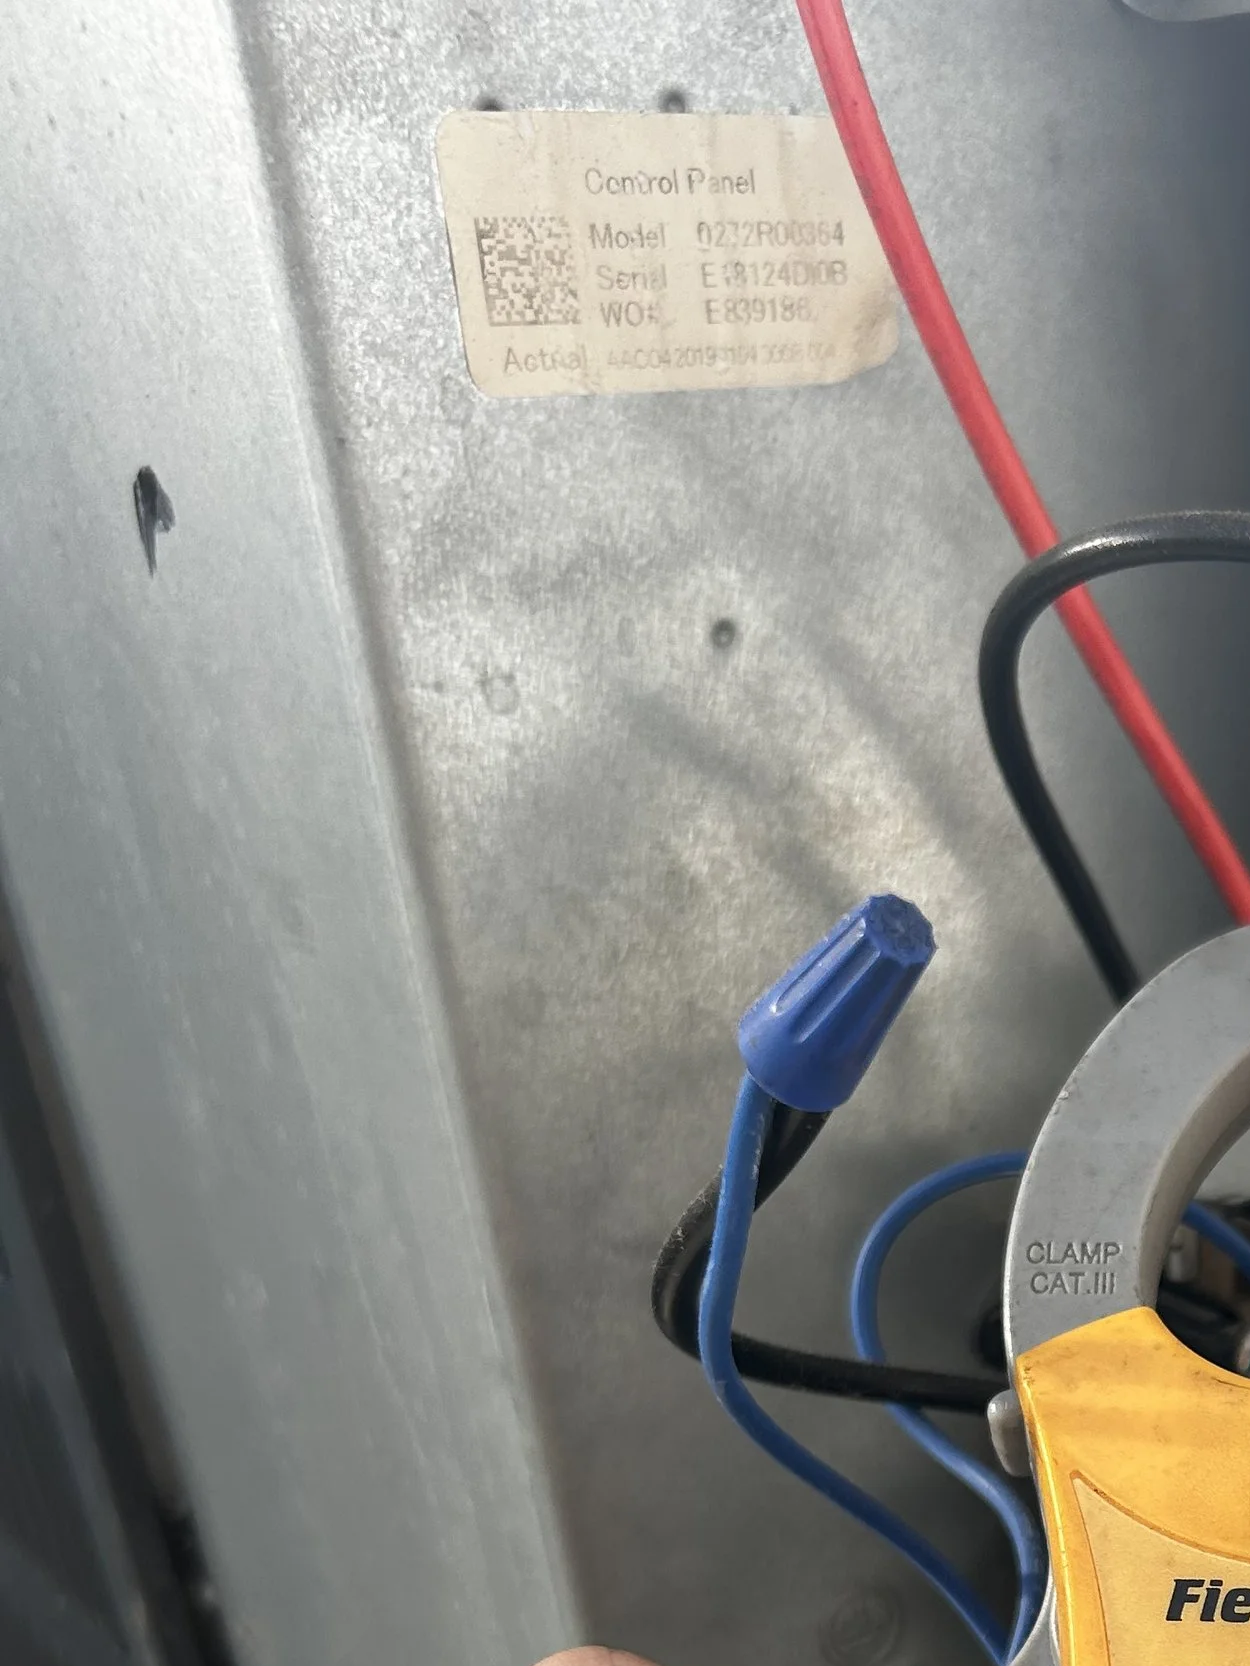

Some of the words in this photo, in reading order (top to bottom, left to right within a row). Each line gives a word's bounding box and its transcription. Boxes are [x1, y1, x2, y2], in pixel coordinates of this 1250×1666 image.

[585, 168, 678, 196] Control
[688, 168, 756, 195] Panel
[589, 221, 666, 250] Model
[598, 264, 667, 292] Serial
[1026, 1241, 1121, 1266] CLAMP
[1030, 1270, 1117, 1296] CAT.III
